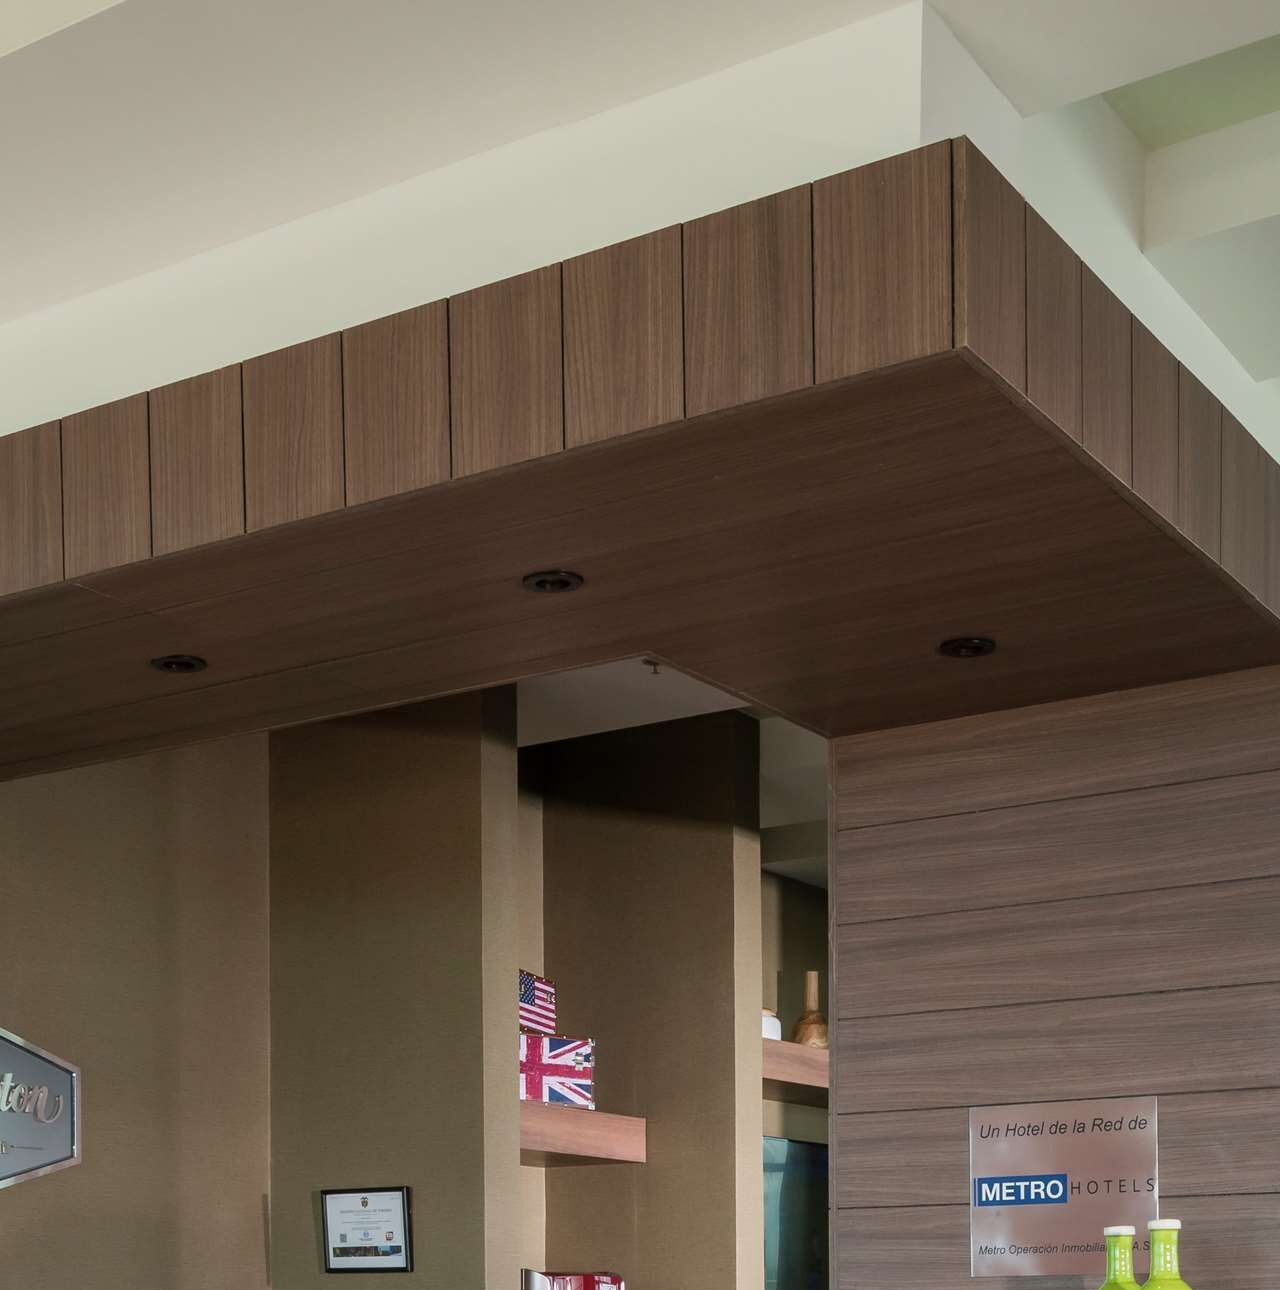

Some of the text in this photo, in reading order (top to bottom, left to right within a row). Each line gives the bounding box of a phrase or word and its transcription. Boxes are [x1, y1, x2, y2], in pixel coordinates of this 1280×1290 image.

[979, 1115, 1148, 1139] Un Hotel de la Red de
[981, 1178, 1155, 1202] METRO HOTELS
[978, 1245, 1006, 1256] Metro
[1008, 1243, 1059, 1256] Operación
